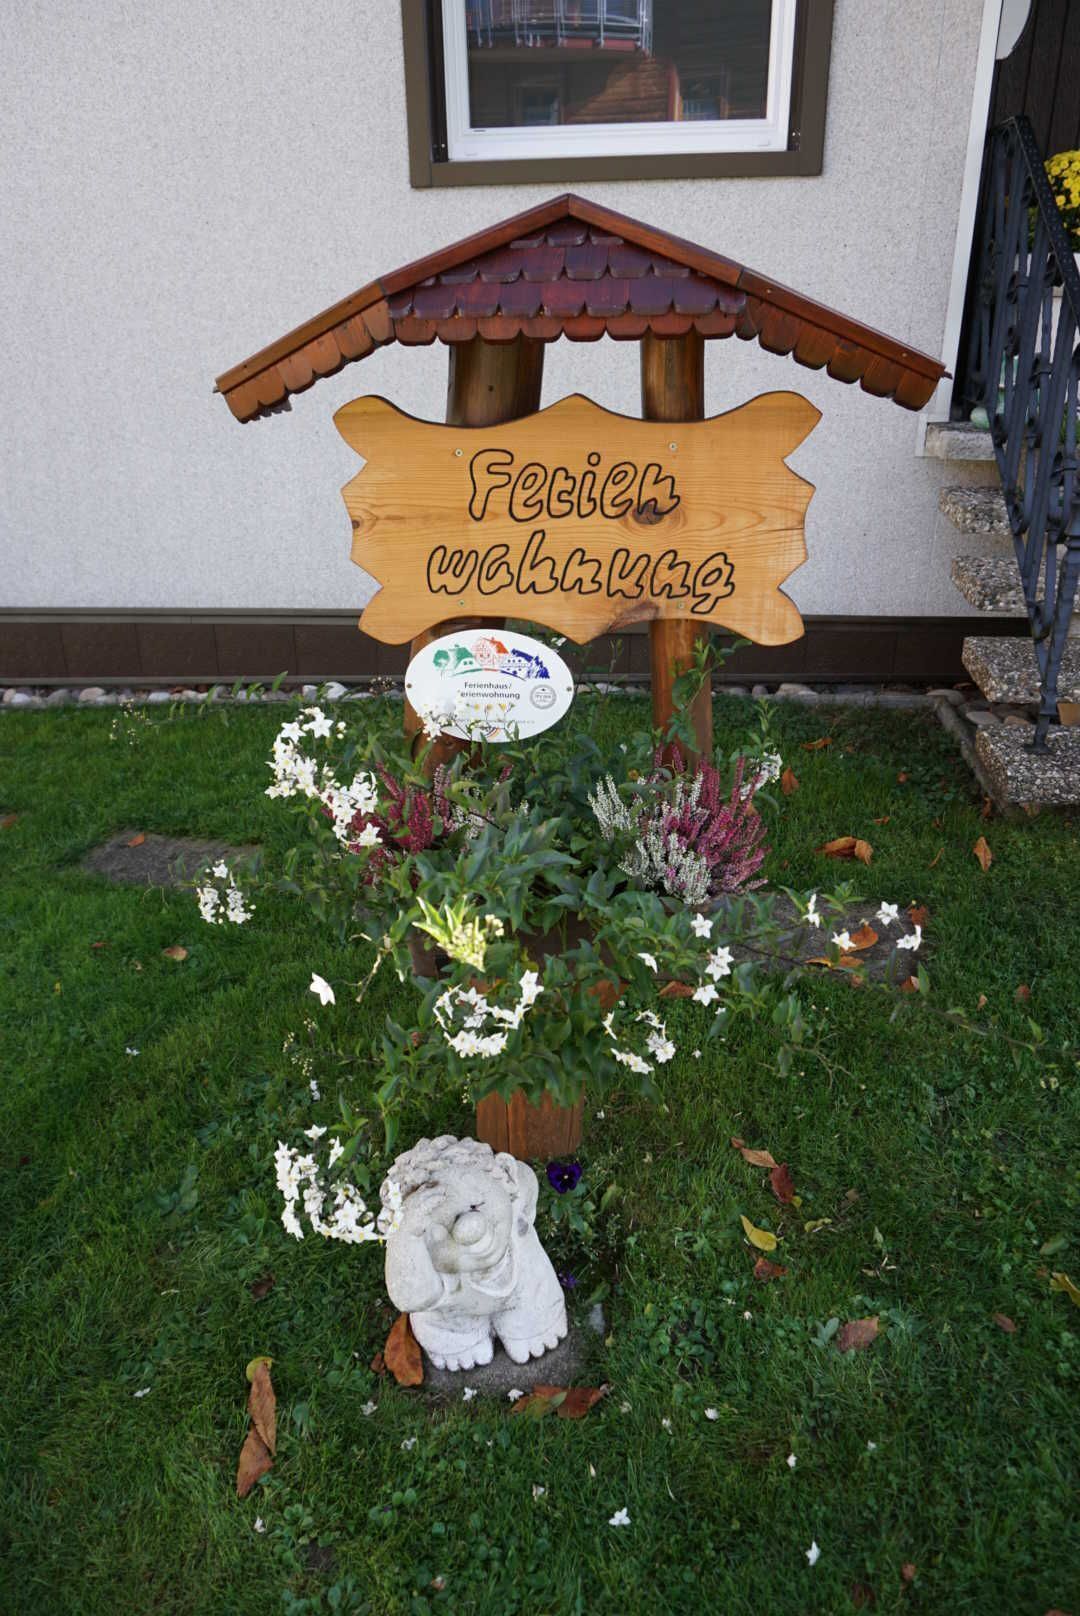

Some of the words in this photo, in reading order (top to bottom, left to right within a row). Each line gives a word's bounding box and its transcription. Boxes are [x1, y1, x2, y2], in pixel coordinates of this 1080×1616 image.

[469, 448, 680, 522] Ferien
[464, 681, 512, 690] Ferienhaus/
[459, 691, 521, 700] erienwohnung
